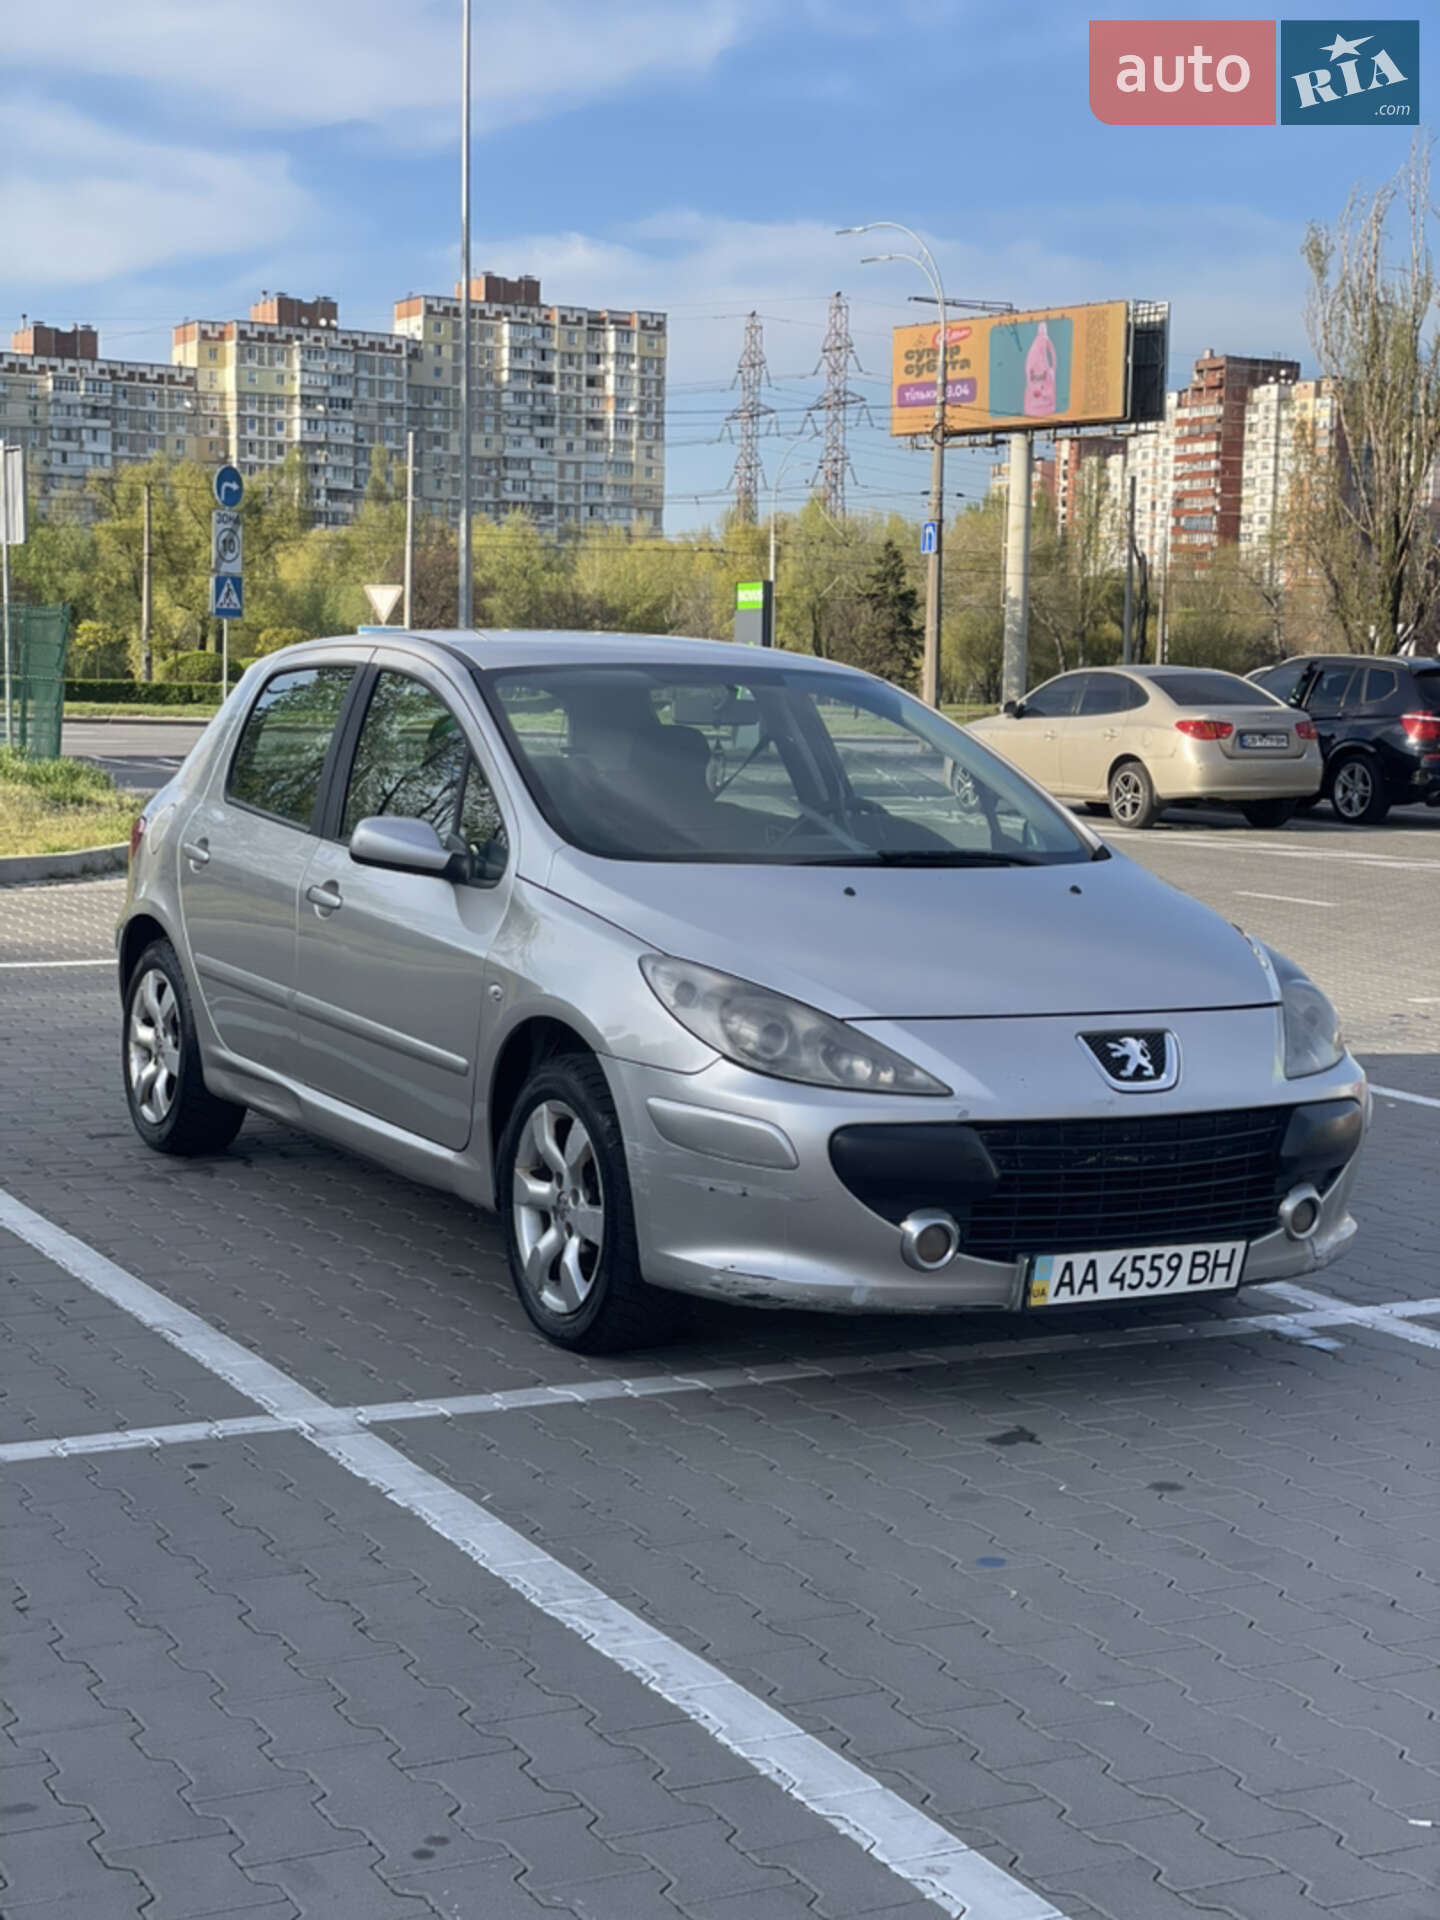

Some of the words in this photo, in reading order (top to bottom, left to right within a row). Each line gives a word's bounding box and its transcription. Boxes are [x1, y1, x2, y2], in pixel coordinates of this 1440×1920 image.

[904, 345, 961, 363] супр
[904, 358, 971, 378] субта
[942, 383, 970, 399] 9.04
[222, 538, 236, 553] 10
[1053, 1258, 1099, 1297] AA
[1108, 1252, 1183, 1292] 4559
[1187, 1248, 1237, 1286] BH
[1032, 1288, 1047, 1298] UA
